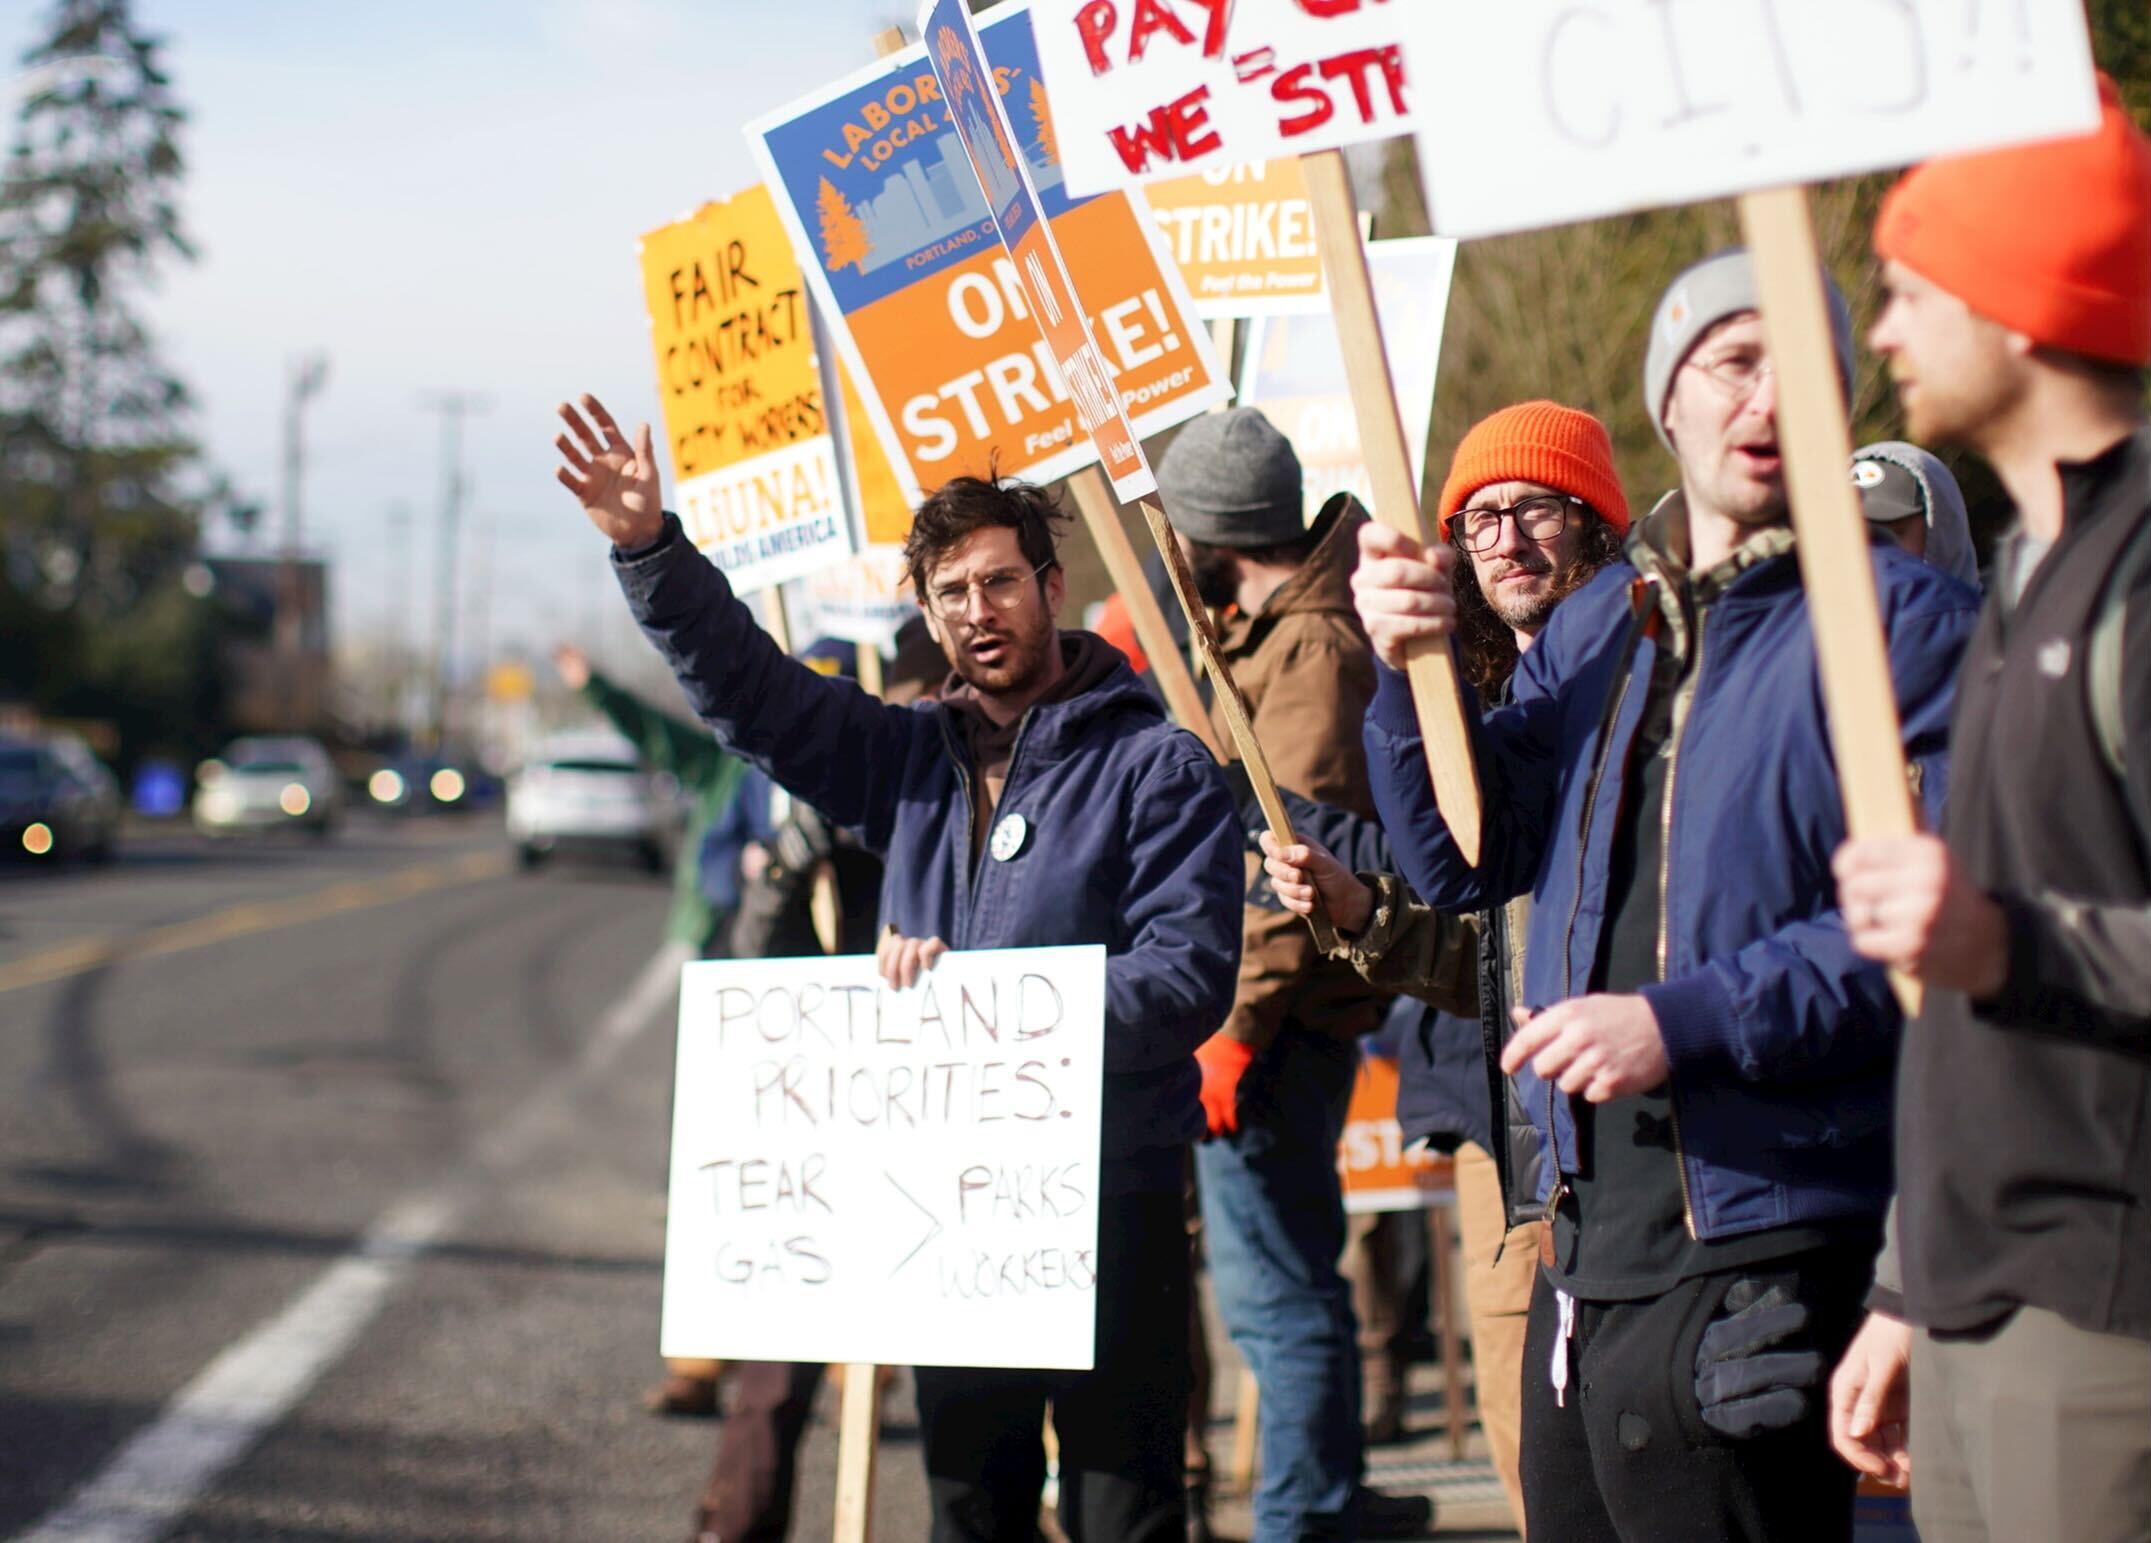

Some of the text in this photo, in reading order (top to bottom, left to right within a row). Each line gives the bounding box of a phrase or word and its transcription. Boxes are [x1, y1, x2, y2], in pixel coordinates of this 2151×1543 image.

[1073, 0, 1235, 77] PAY
[821, 66, 1023, 170] LABORS'
[860, 114, 938, 173] LOCAL
[1106, 85, 1223, 175] WE
[669, 240, 759, 331] FAIR
[947, 257, 1027, 340] ON
[666, 289, 799, 396] CONTRACT
[1023, 418, 1073, 456] Feel
[1122, 365, 1194, 411] Power
[715, 973, 1064, 1049] PORTLAND
[699, 1153, 833, 1215] TEAR
[958, 1162, 1087, 1224] PARKS
[714, 1236, 833, 1292] GAS
